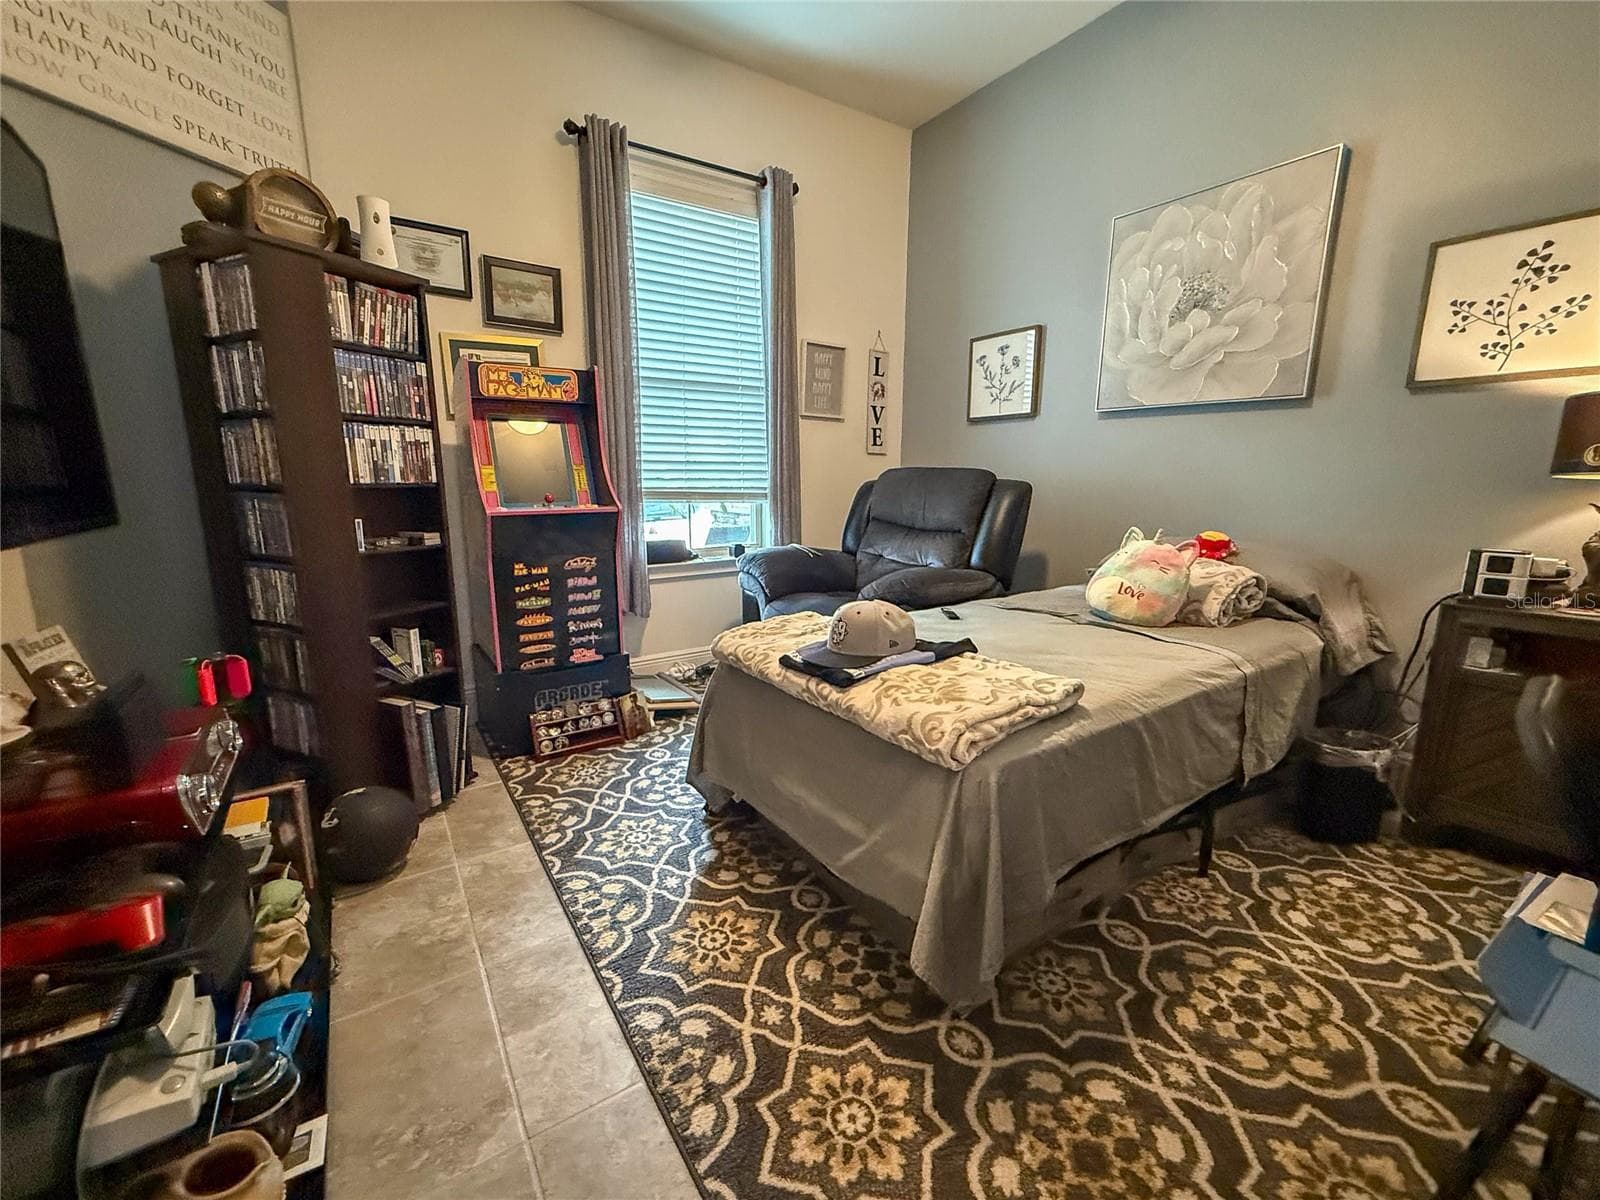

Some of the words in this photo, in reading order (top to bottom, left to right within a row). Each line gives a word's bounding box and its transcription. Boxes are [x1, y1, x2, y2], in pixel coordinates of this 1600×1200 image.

[13, 15, 101, 70] HAPPY
[14, 0, 92, 42] GIVE
[103, 35, 157, 72] AND
[165, 64, 244, 117] FORGET
[253, 111, 294, 142] LOVE
[147, 9, 222, 63] LAUGH
[230, 58, 288, 99] SHARE
[176, 3, 246, 56] THANK
[249, 47, 286, 80] YOU
[78, 74, 166, 122] GRACE
[172, 114, 234, 155] SPEAK
[238, 144, 297, 175] TRU
[267, 205, 296, 219] HAPPY
[297, 215, 321, 227] HOUR
[488, 382, 562, 398] PAC-MAN
[1117, 581, 1145, 600] Love
